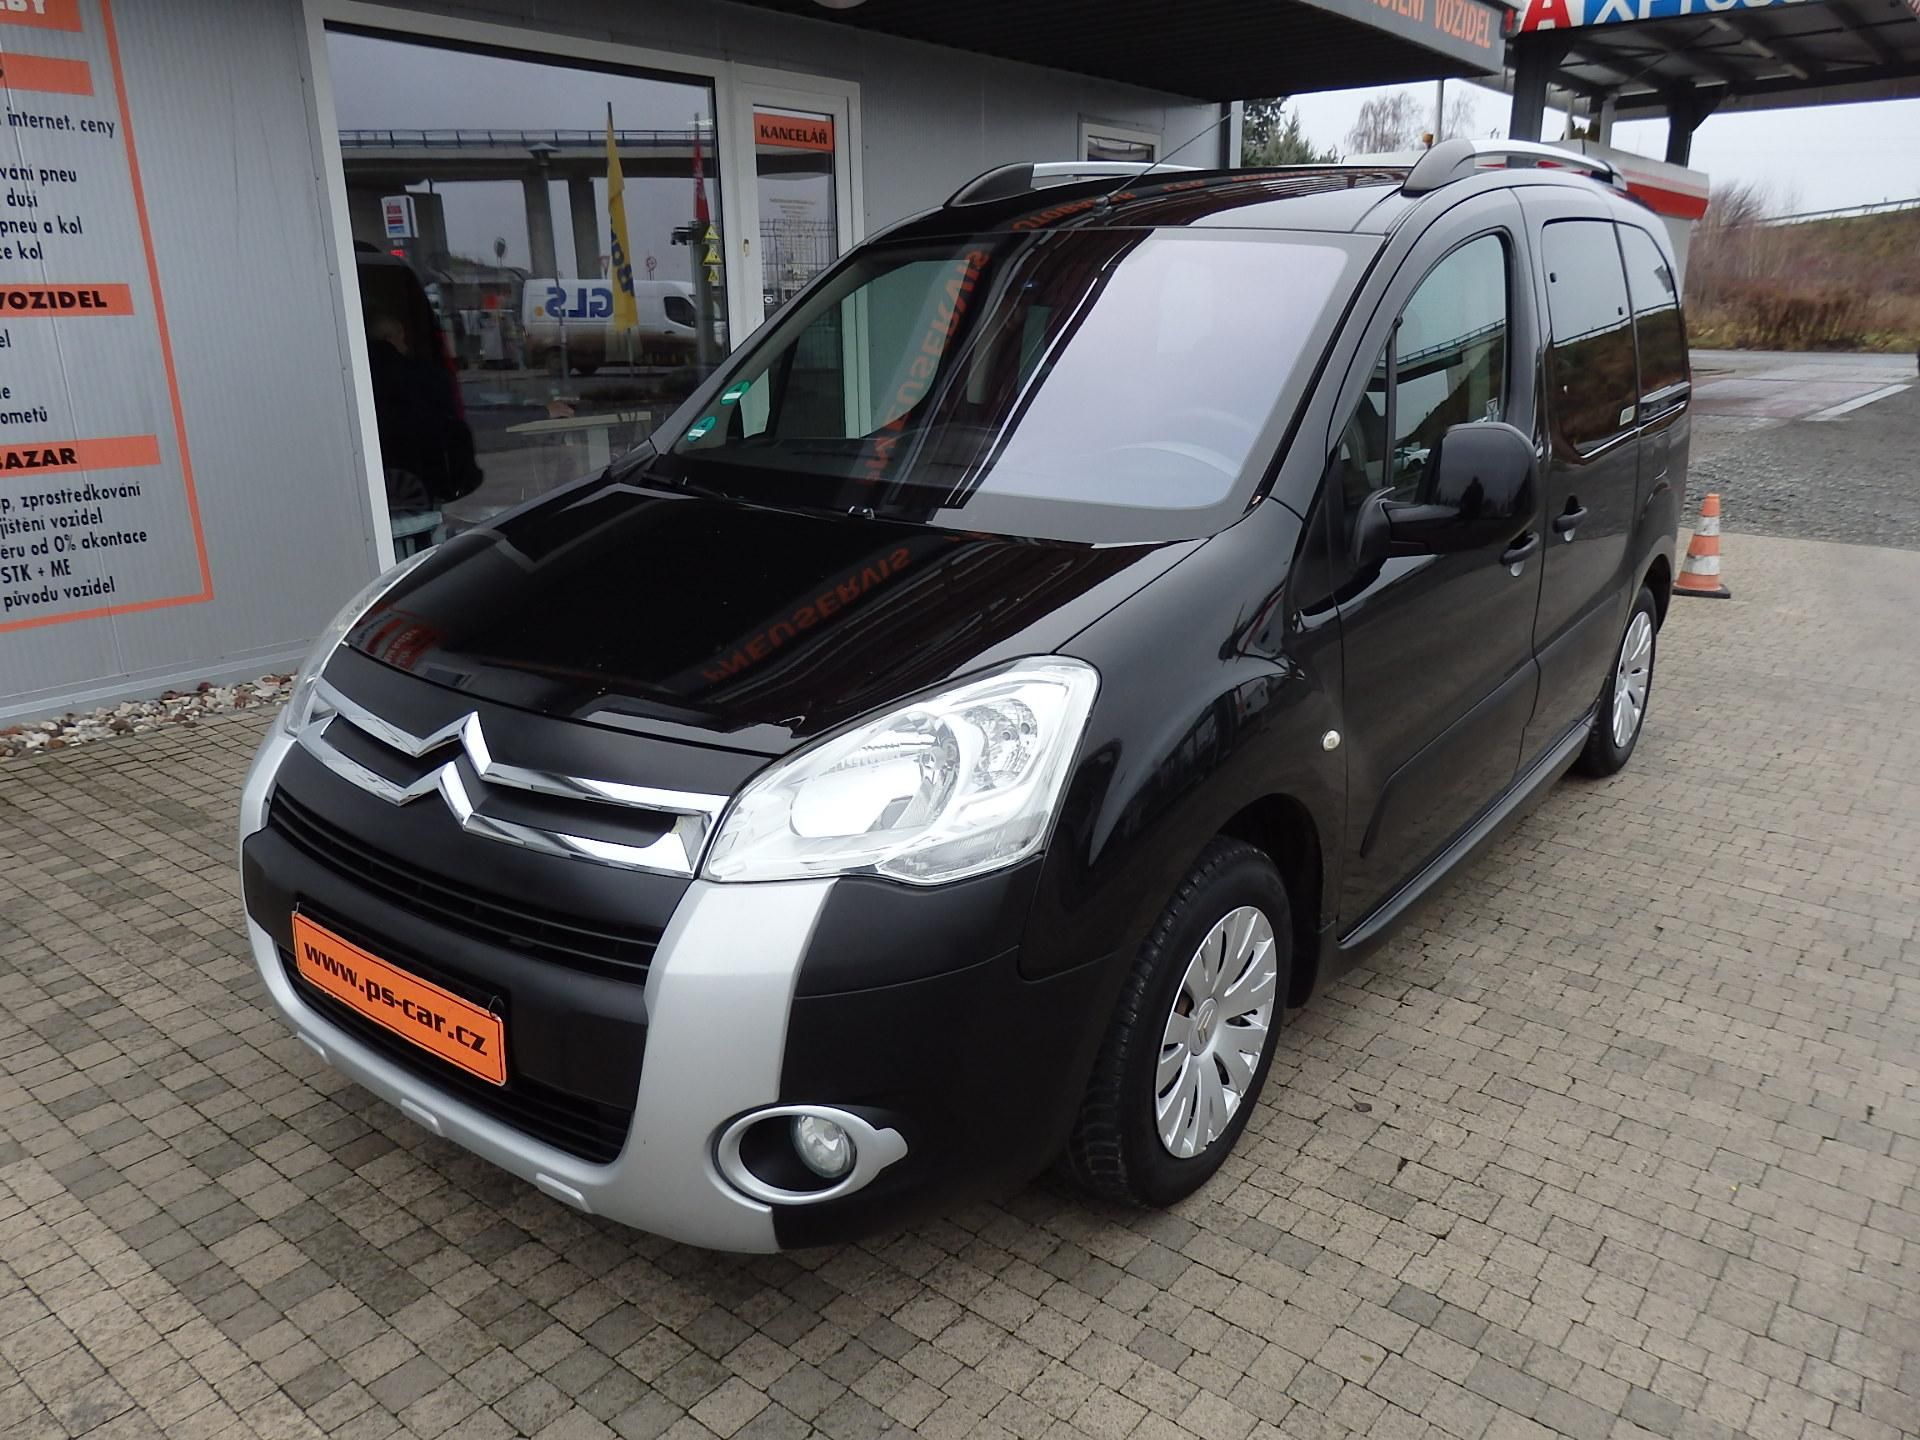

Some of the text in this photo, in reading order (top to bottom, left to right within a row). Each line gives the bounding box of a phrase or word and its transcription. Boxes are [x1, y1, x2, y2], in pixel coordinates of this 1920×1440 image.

[7, 106, 115, 139] internet. ceny
[760, 125, 828, 145] KANCELÁŘ
[40, 168, 77, 186] pneu
[7, 187, 39, 208] duší
[0, 215, 83, 238] pneu a kol
[17, 241, 43, 260] kol
[0, 448, 77, 470] AZAR
[21, 481, 141, 511] zprostředkování
[50, 507, 103, 528] vozidel
[31, 537, 49, 555] od
[54, 534, 76, 552] 0%
[82, 530, 148, 550] akontace
[1, 564, 32, 584] STK
[50, 558, 72, 578] ME
[3, 576, 115, 612] původu vozidel
[303, 942, 488, 1057] www.ps-car.cz
